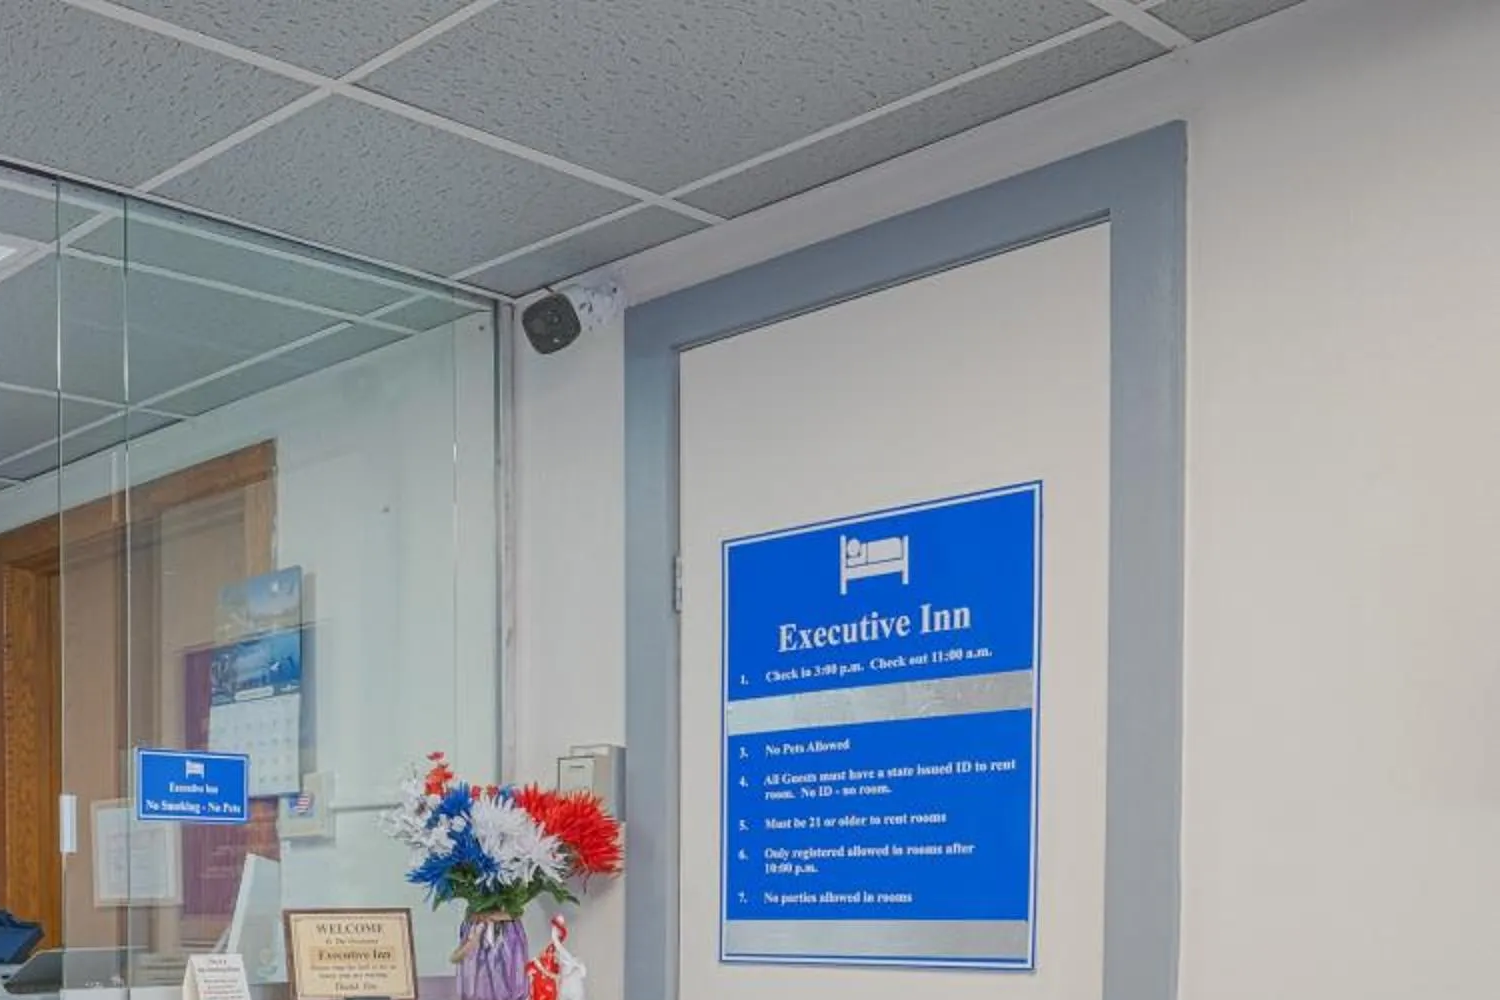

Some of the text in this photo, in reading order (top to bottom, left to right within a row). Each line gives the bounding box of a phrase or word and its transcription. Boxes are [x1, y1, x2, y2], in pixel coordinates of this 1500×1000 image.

[778, 603, 972, 653] Executive Inn
[765, 668, 799, 683] Check
[814, 663, 838, 678] 3:00
[869, 655, 907, 671] Check
[909, 652, 929, 666] out
[931, 647, 963, 664] 11:00
[965, 646, 994, 660] a.m.
[765, 744, 781, 757] No
[783, 742, 805, 755] Pets
[805, 738, 850, 753] Allowed
[764, 773, 780, 786] All
[781, 772, 818, 785] Guests
[819, 770, 847, 783] must
[848, 768, 876, 781] have
[887, 766, 915, 778] state
[917, 762, 954, 776] issued
[955, 760, 972, 773] ID
[974, 760, 988, 772] to
[989, 758, 1017, 771] rent
[800, 787, 818, 799] No
[819, 785, 834, 797] ID
[146, 799, 160, 811] No
[161, 800, 201, 815] Smoking
[208, 801, 221, 813] No
[765, 817, 792, 830] Must
[793, 816, 807, 829] be
[808, 816, 822, 828] 21
[823, 817, 837, 828] or
[838, 815, 868, 828] older
[869, 815, 882, 826] to
[883, 812, 909, 826] rent
[910, 813, 948, 825] rooms
[764, 847, 792, 862] Only
[792, 845, 846, 860] registered
[847, 844, 890, 859] allowed
[891, 844, 904, 856] in
[906, 844, 944, 856] rooms
[945, 842, 976, 856] after
[764, 891, 779, 904] No
[780, 891, 818, 906] parties
[819, 891, 861, 904] allowed
[862, 890, 875, 904] in
[876, 892, 914, 904] rooms
[315, 922, 385, 935] WELCOME
[318, 948, 371, 961] Executive
